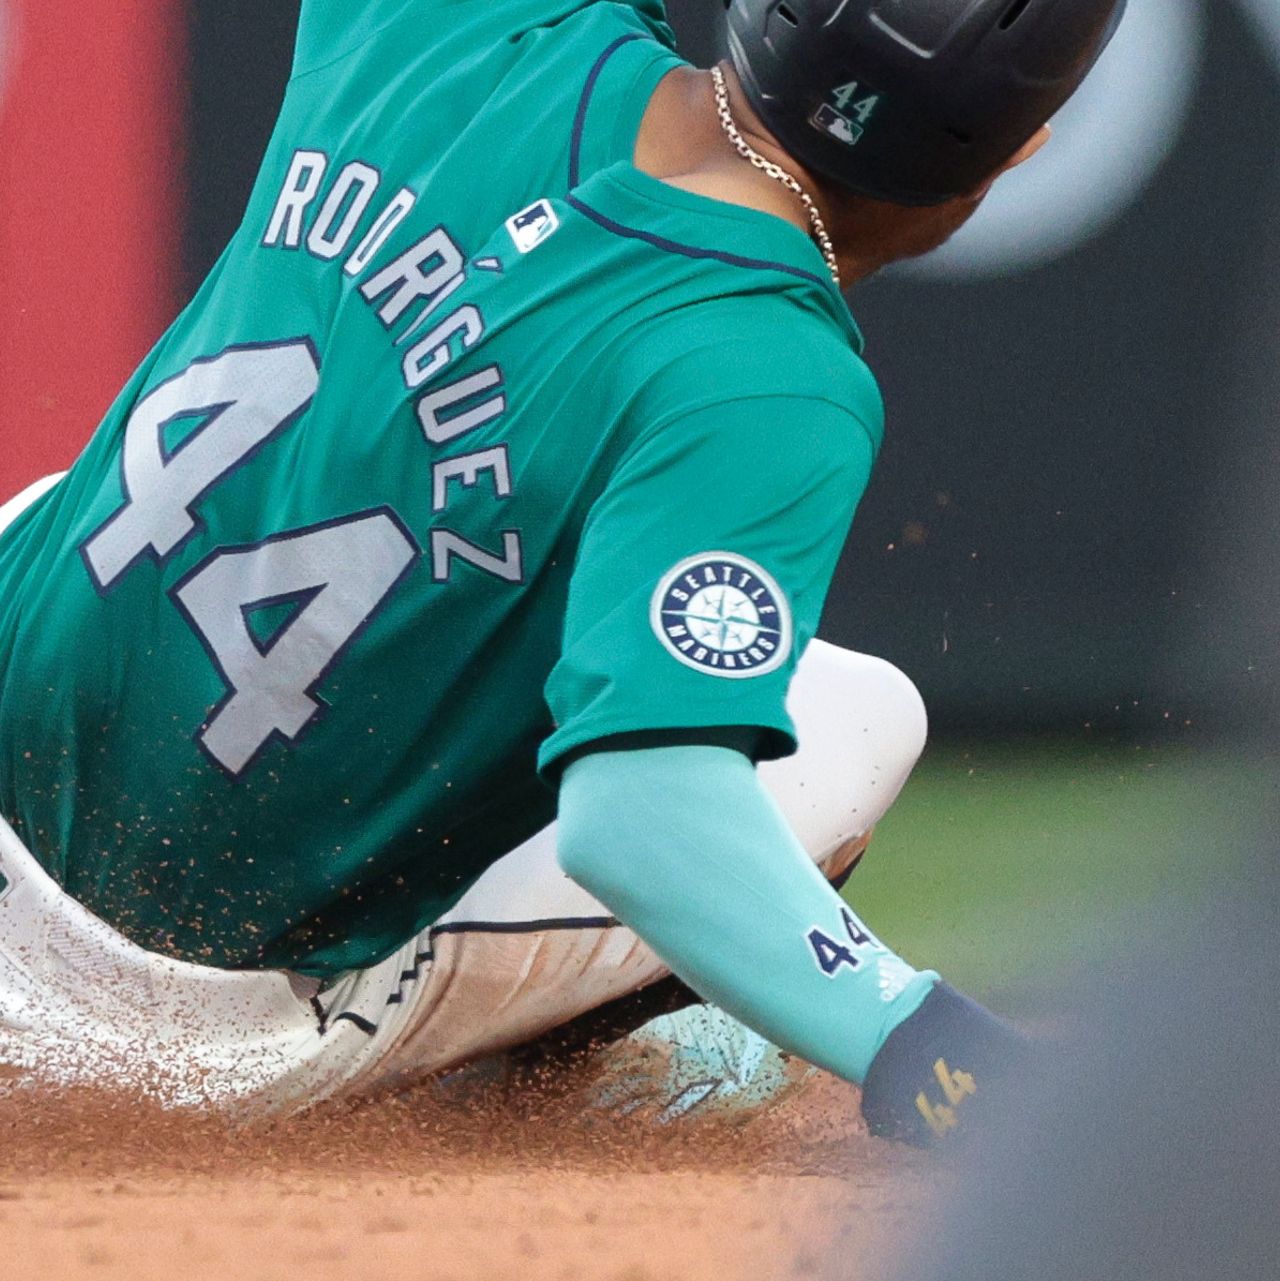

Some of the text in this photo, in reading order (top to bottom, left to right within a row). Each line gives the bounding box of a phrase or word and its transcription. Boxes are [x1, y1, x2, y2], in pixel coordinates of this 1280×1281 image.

[831, 81, 879, 124] 44
[260, 148, 524, 586] RODRÍGUEZ
[78, 334, 423, 782] 44
[671, 566, 777, 615] SEATTLE
[666, 624, 776, 668] MARINERS
[915, 1057, 977, 1138] 44
